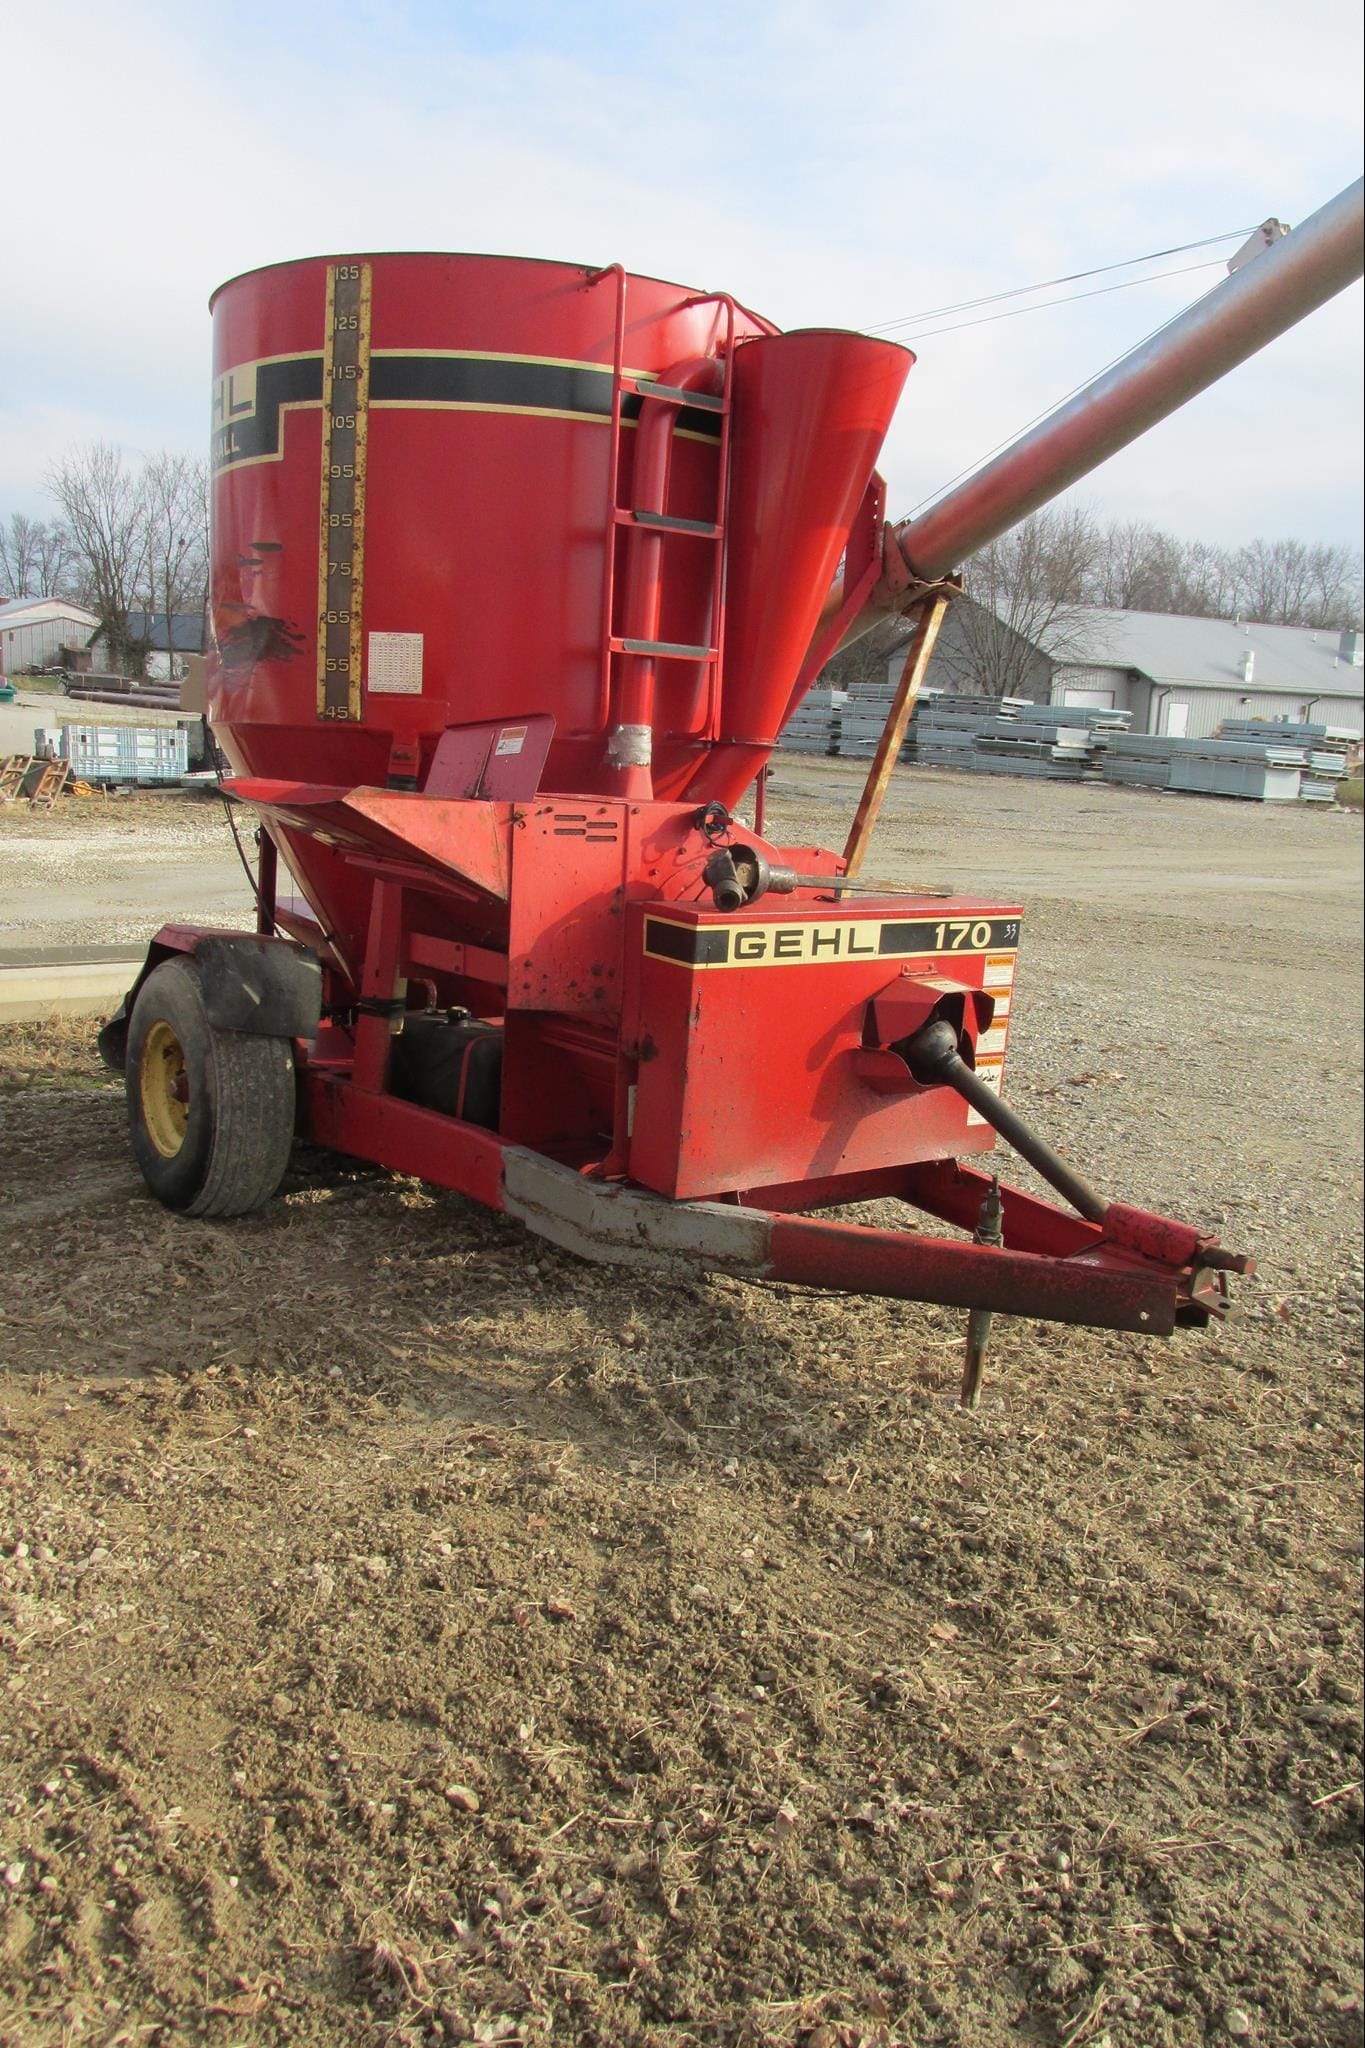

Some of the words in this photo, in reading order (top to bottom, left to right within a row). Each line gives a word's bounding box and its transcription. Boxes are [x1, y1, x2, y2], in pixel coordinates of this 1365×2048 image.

[335, 265, 359, 281] 135
[334, 316, 358, 330] 125
[332, 365, 357, 380] 115
[331, 415, 356, 429] 105
[330, 464, 354, 478] 95
[329, 513, 353, 527] 85
[328, 562, 352, 576] 75
[327, 610, 350, 624] 65
[326, 658, 349, 672] 55
[325, 705, 348, 719] 45
[734, 927, 874, 960] GEHL
[935, 921, 992, 949] 170
